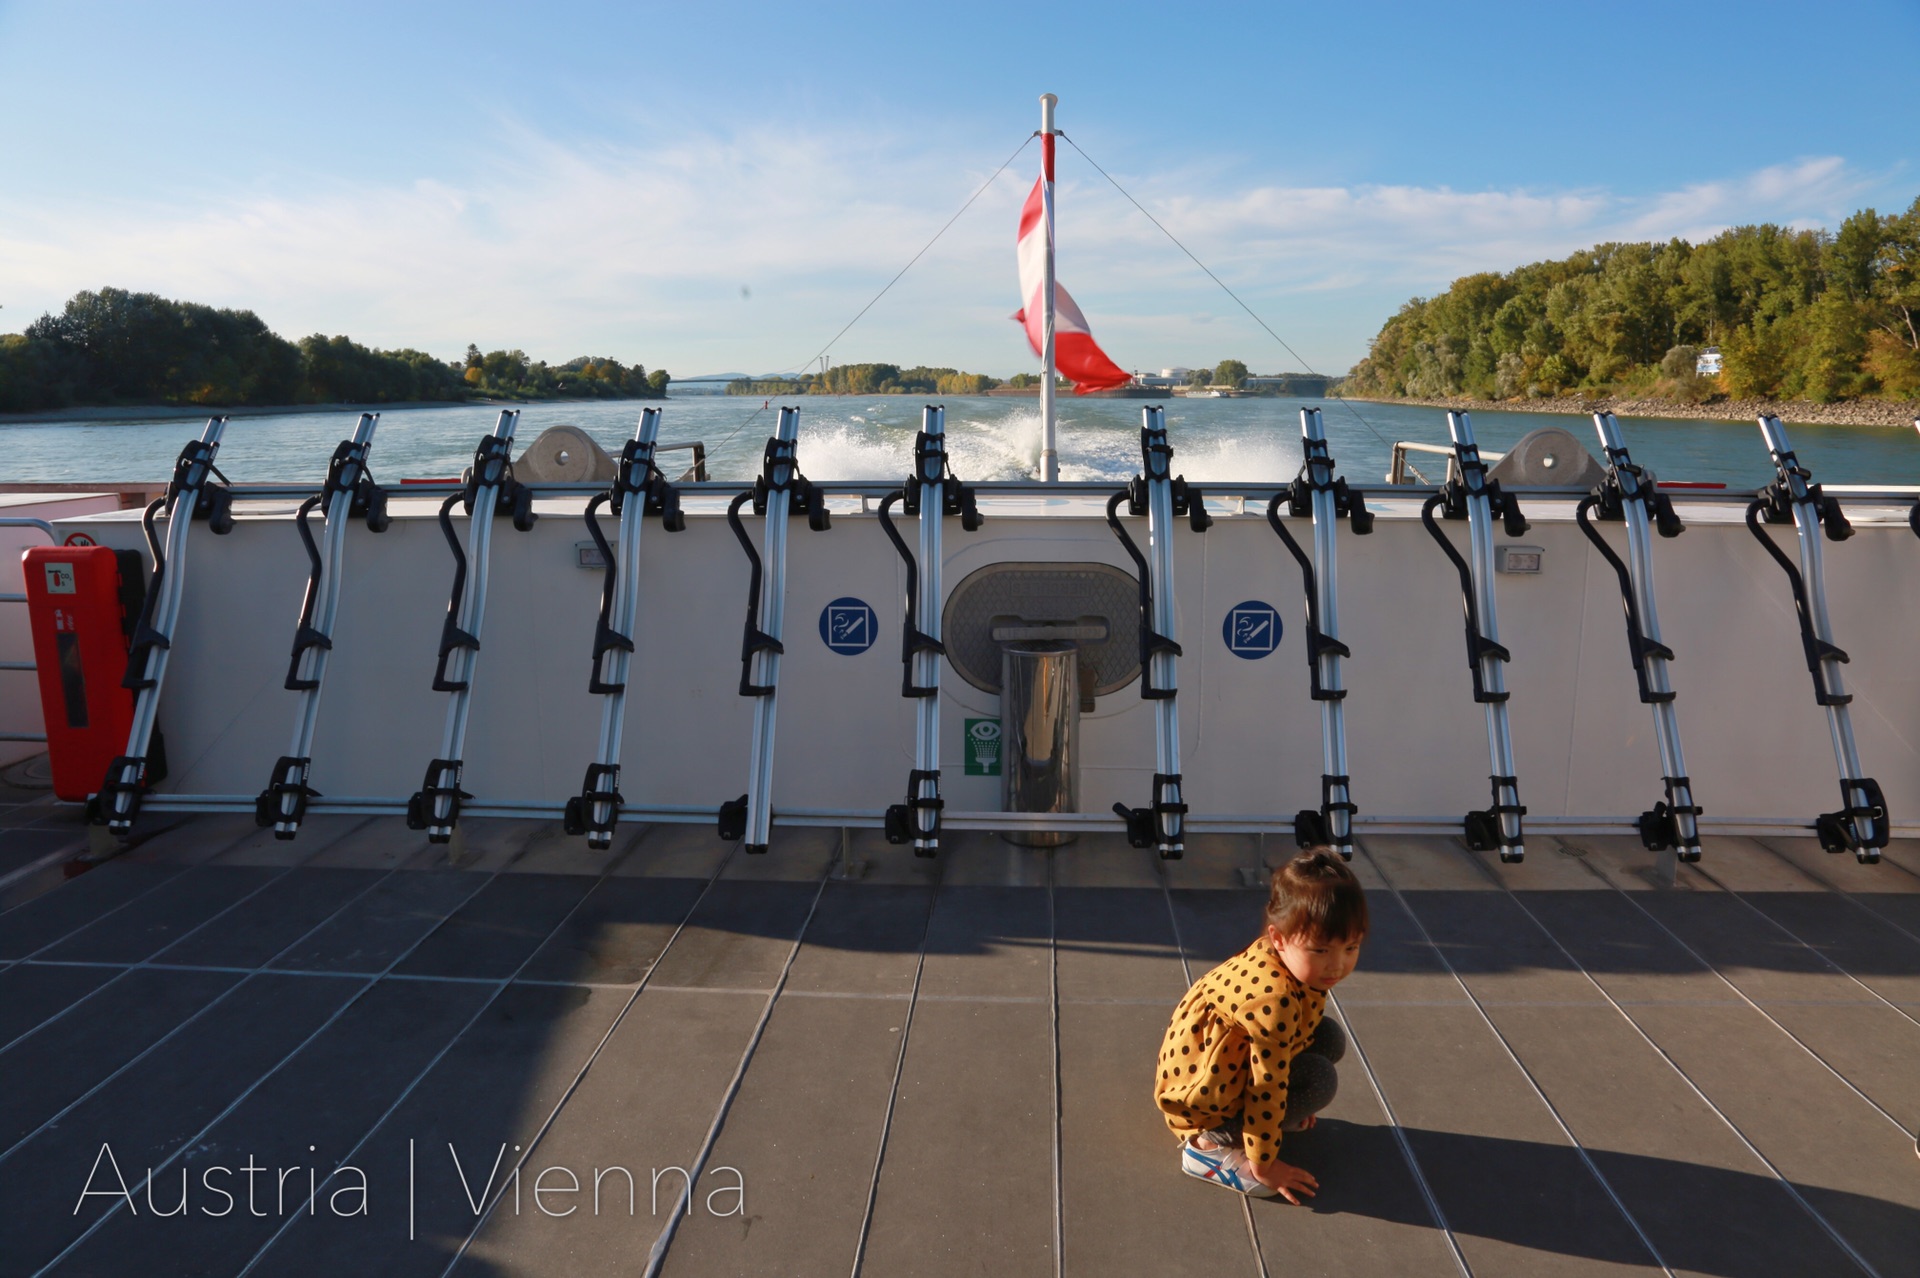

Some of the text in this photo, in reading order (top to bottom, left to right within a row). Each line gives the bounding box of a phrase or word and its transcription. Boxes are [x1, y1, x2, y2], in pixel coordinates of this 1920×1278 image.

[137, 762, 146, 780] THULE
[302, 762, 310, 780] THULE
[455, 765, 463, 784] THULE
